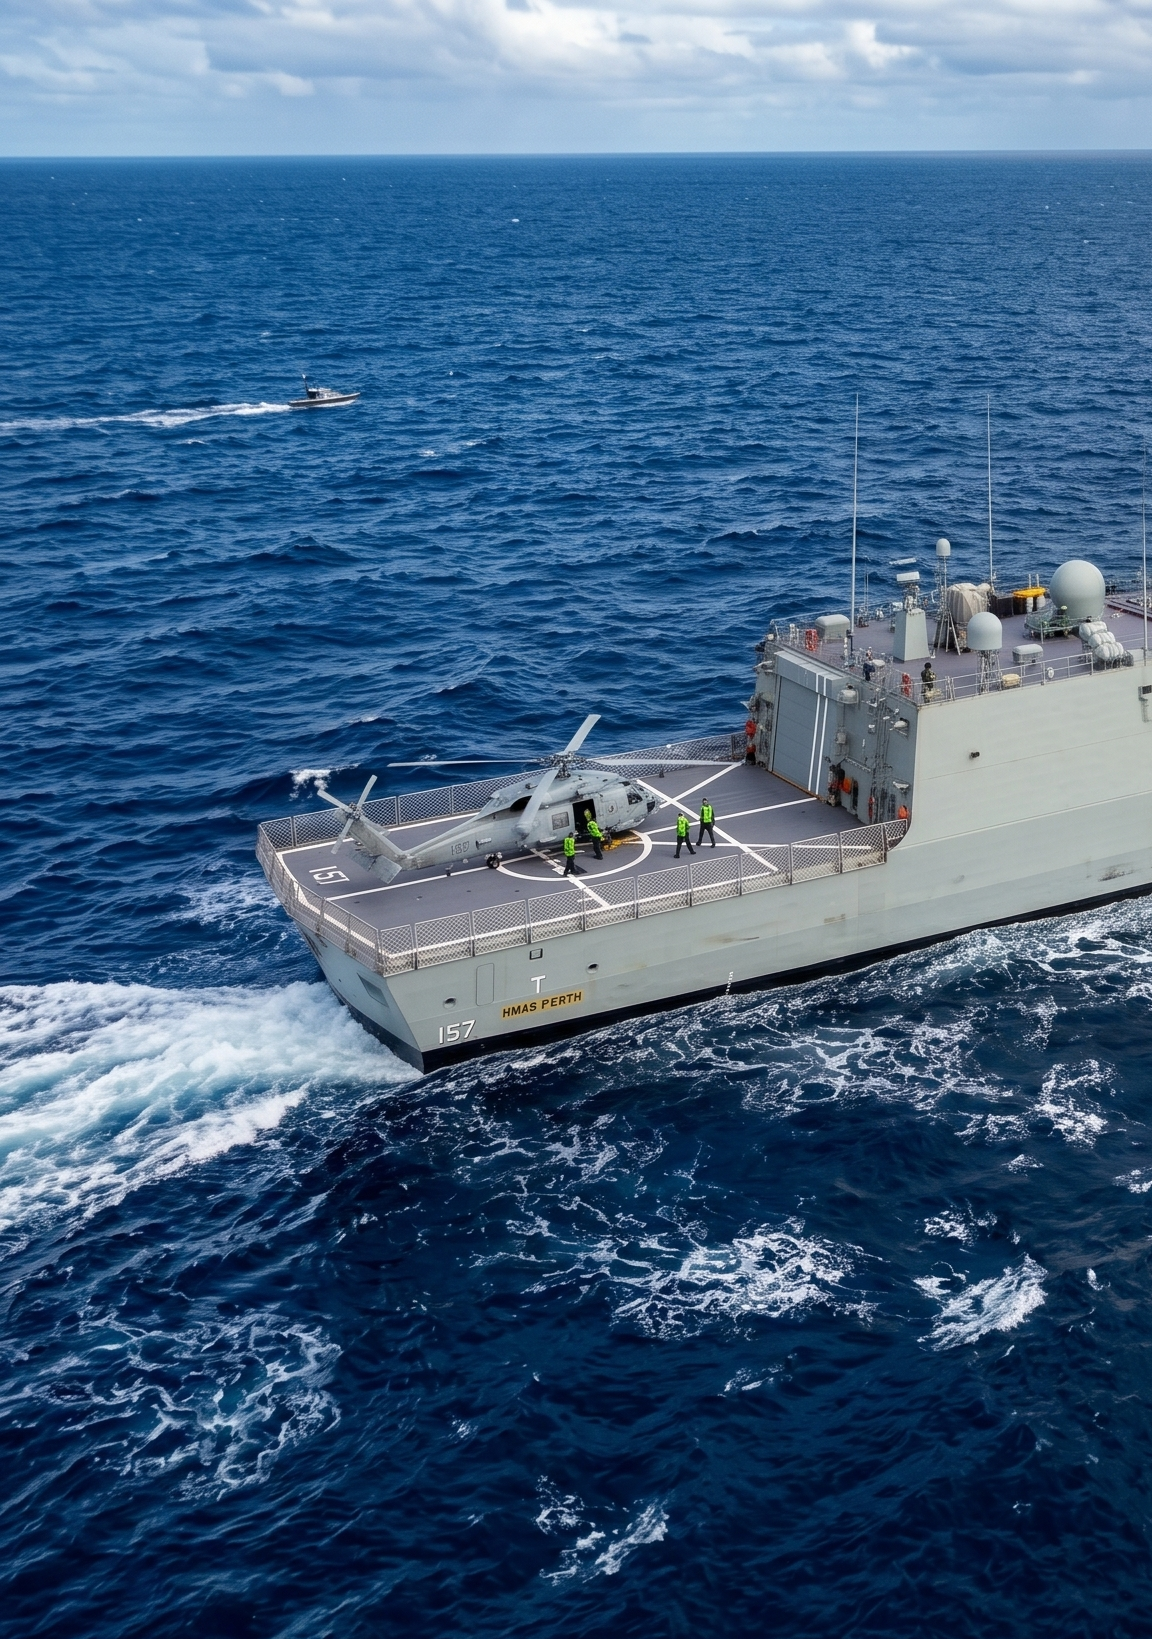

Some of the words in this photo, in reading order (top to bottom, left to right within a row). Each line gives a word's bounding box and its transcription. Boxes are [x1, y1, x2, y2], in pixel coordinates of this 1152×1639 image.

[530, 975, 546, 994] T
[502, 1002, 537, 1018] HMAS
[541, 991, 582, 1010] PERTH
[439, 1019, 476, 1044] 157
